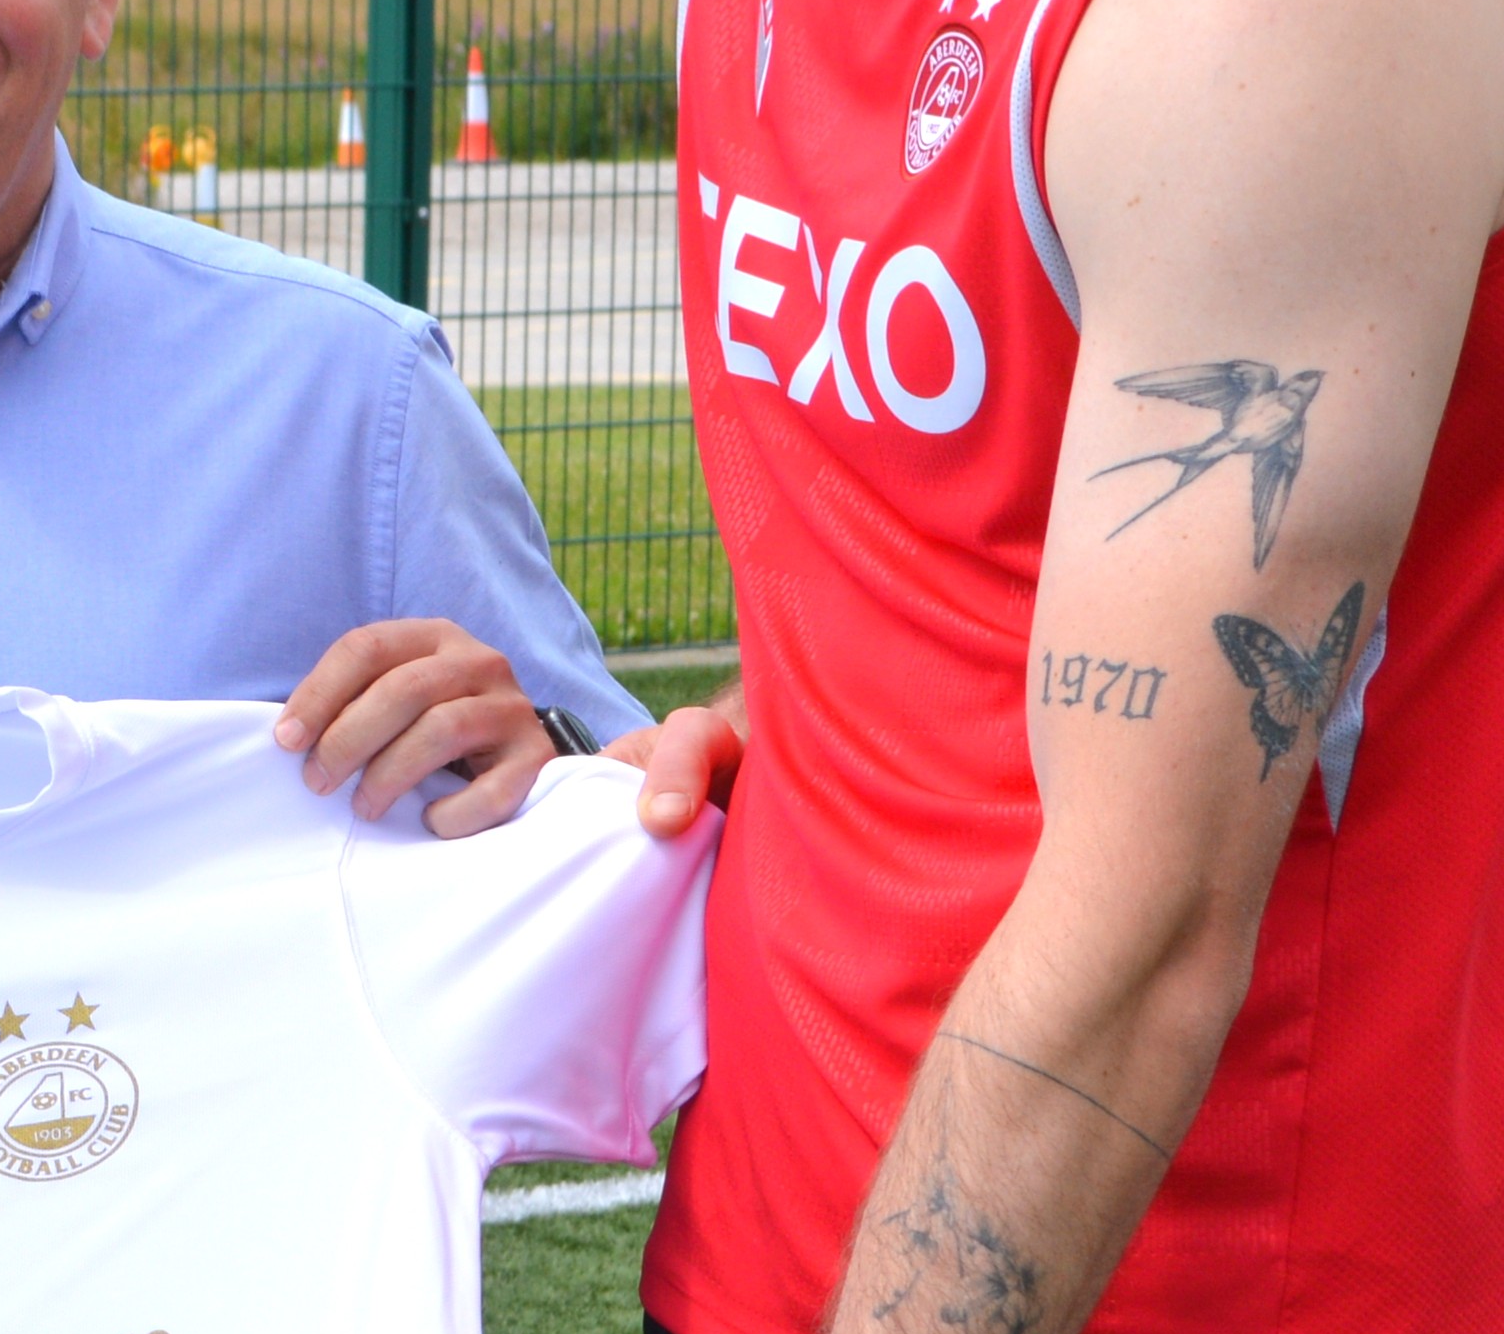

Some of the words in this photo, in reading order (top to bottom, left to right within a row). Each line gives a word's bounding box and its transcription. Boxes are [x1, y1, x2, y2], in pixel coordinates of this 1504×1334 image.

[928, 38, 979, 79] ABERDEEN
[1041, 650, 1168, 720] 1970
[33, 1126, 73, 1143] 1903
[87, 1103, 130, 1157] CLUB
